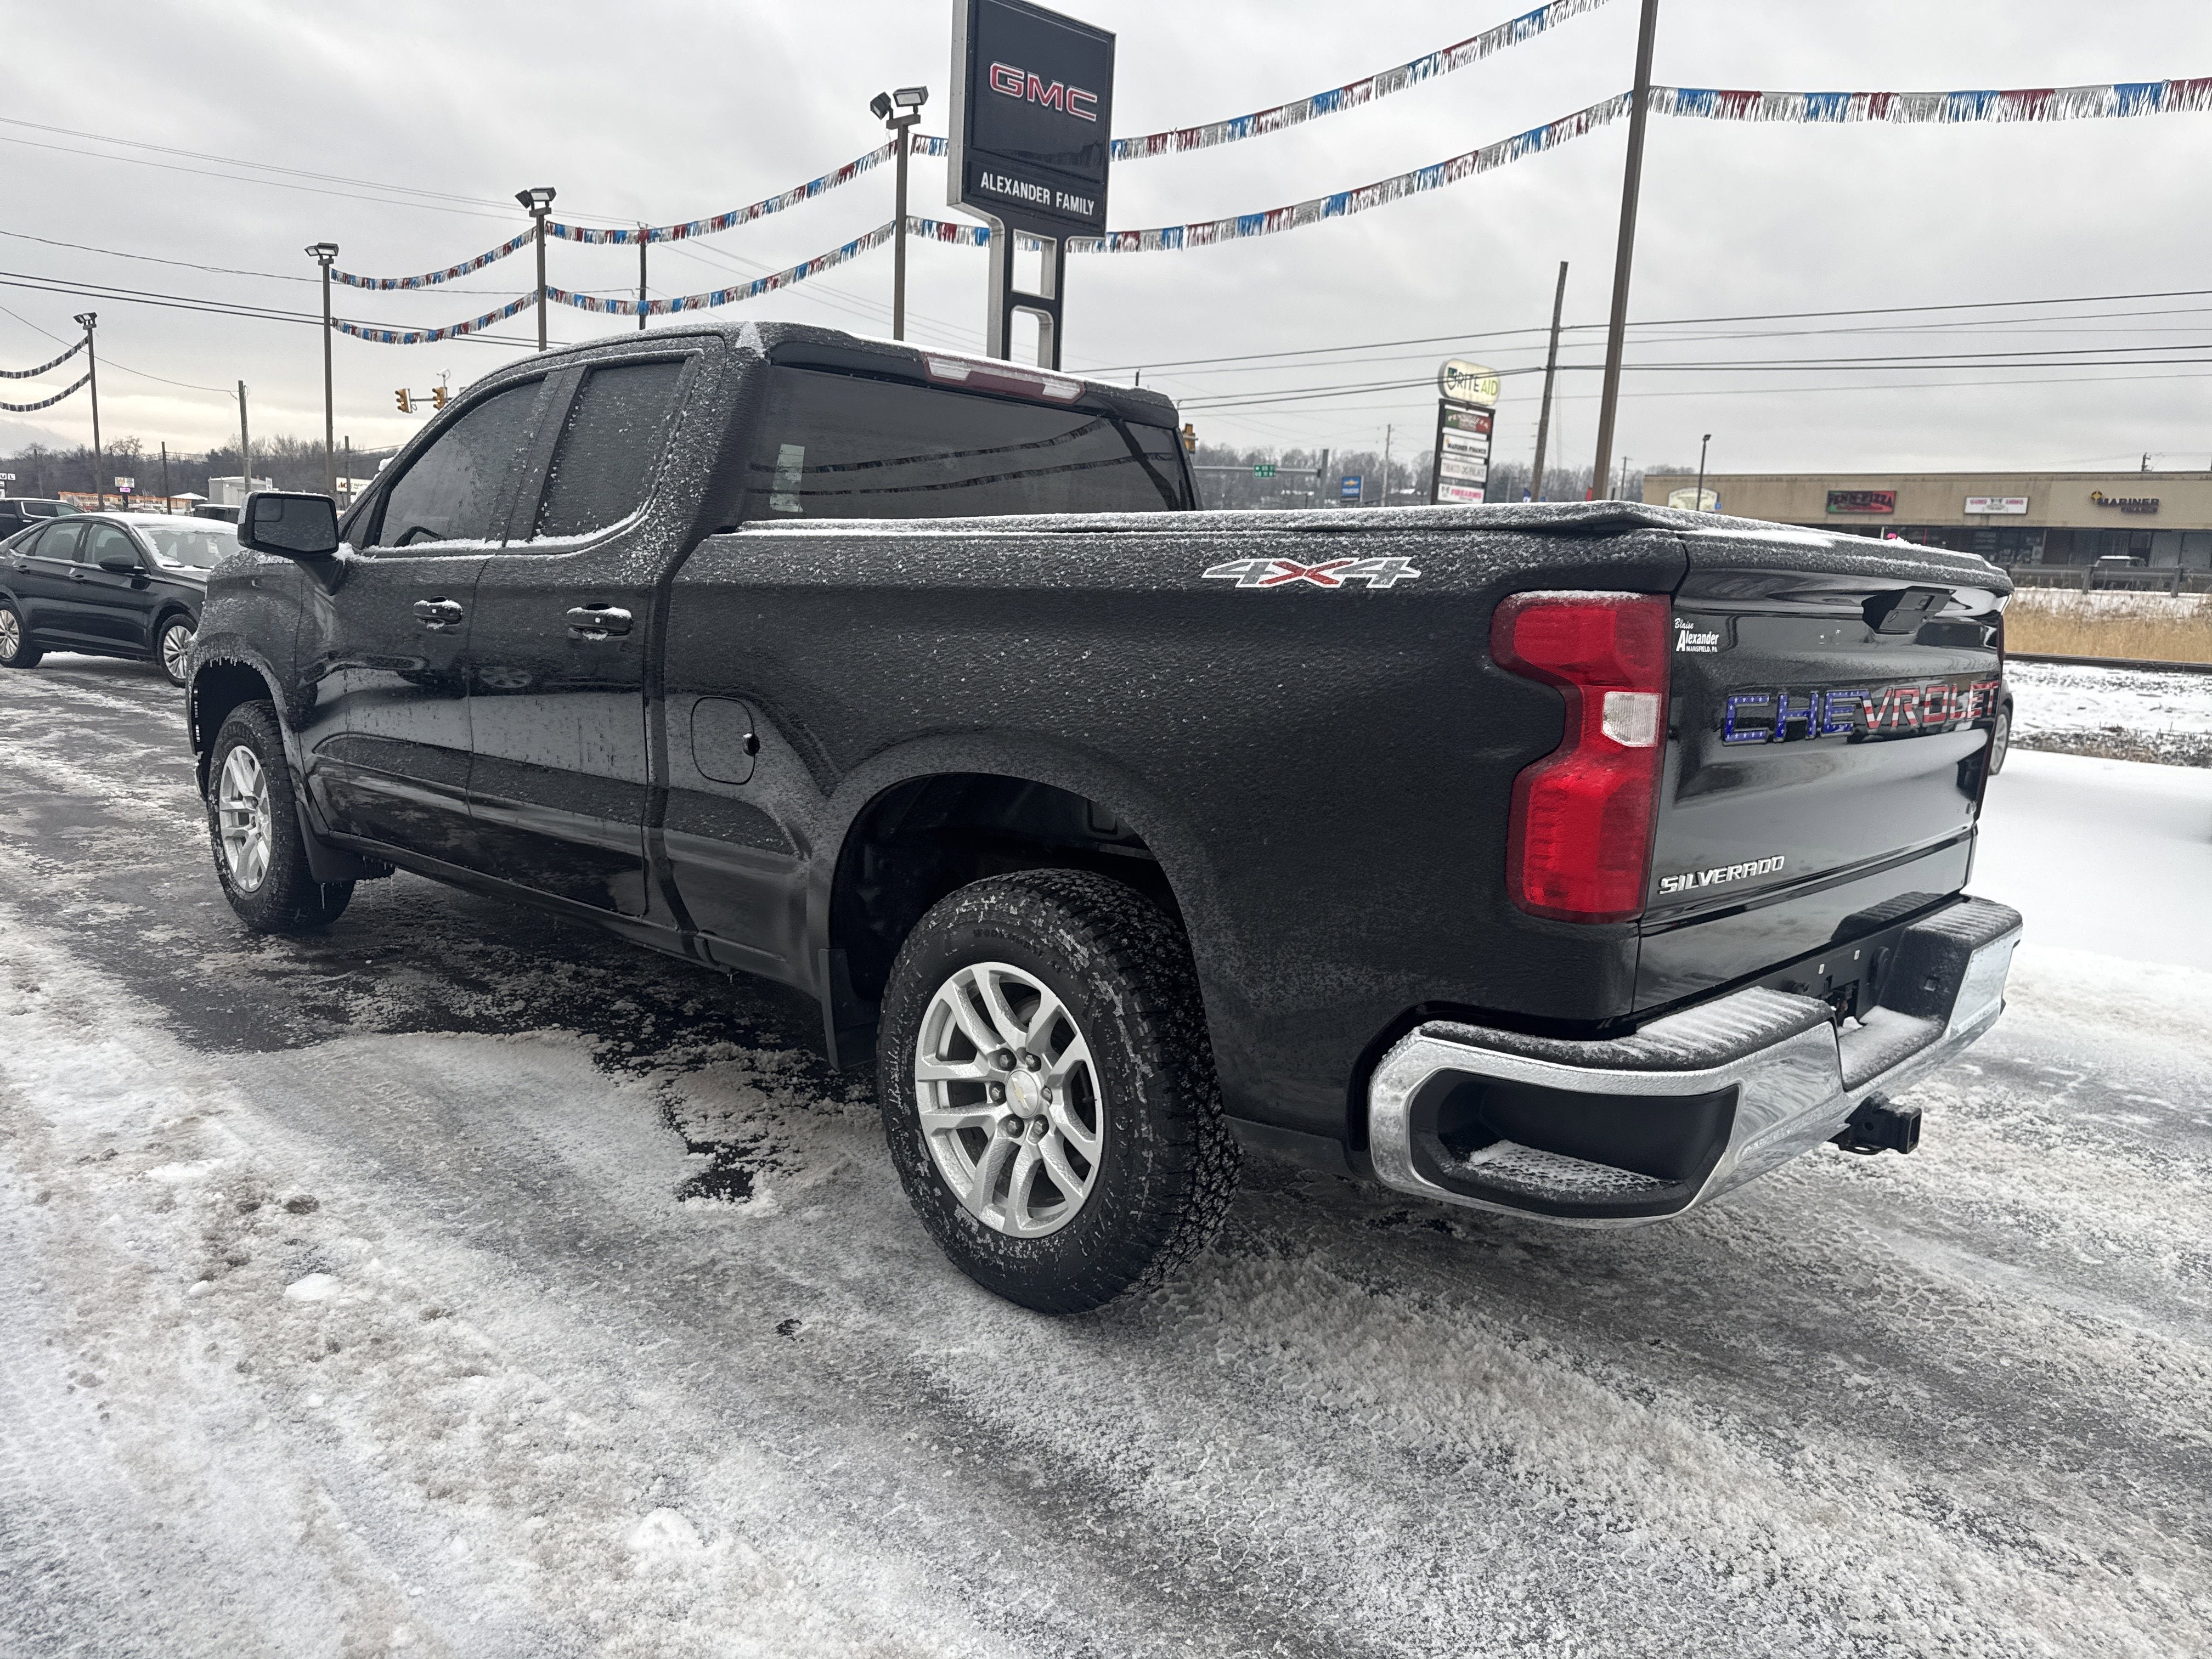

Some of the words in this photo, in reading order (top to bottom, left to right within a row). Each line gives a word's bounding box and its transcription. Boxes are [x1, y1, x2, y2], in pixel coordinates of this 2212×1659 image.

[990, 62, 1097, 121] GMC
[980, 172, 1050, 205] ALEXANDER
[1056, 192, 1094, 216] FAMILY
[1457, 371, 1480, 392] RITE
[1481, 379, 1498, 396] AID
[1674, 618, 1694, 629] Blaise
[1676, 630, 1719, 651] Alexander
[1724, 681, 1999, 744] CHEVROLET
[1658, 855, 1785, 895] SILVERADO
